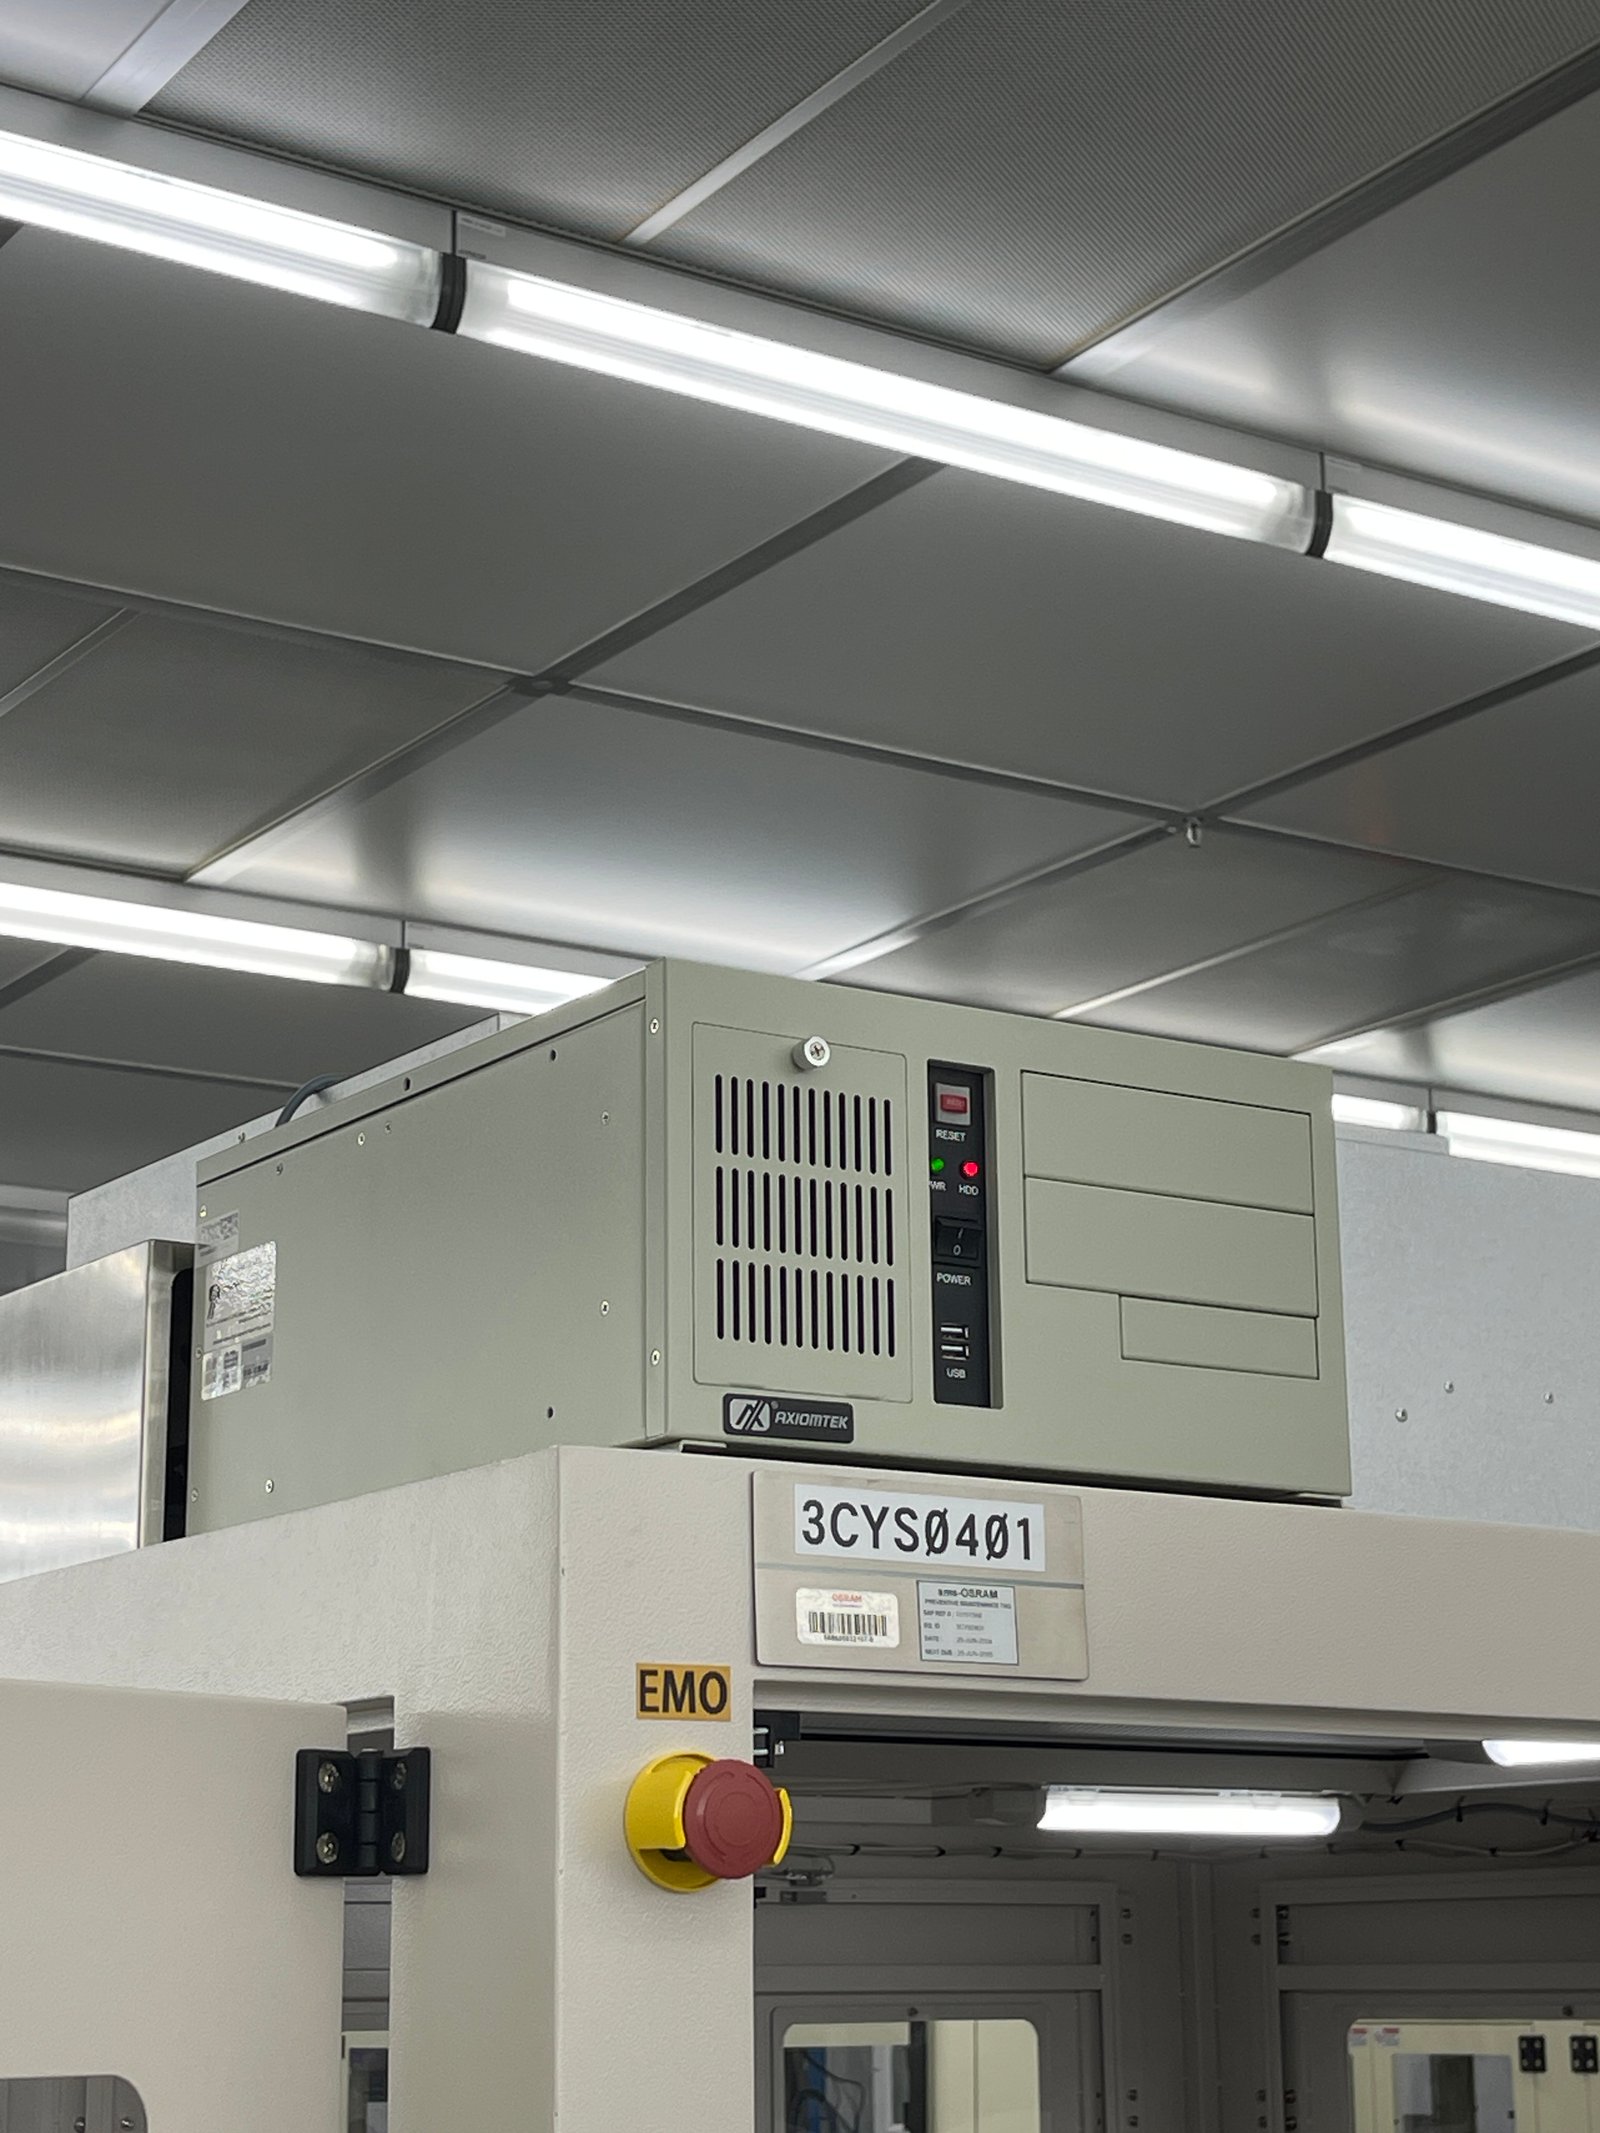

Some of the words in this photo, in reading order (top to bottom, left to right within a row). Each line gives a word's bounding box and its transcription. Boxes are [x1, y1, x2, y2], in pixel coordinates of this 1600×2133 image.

[935, 1128, 967, 1142] RESET
[958, 1184, 980, 1196] HDD
[936, 1272, 972, 1286] POWER
[945, 1367, 967, 1379] USB
[774, 1411, 849, 1430] AXIOMTEK
[639, 1669, 728, 1715] EMO
